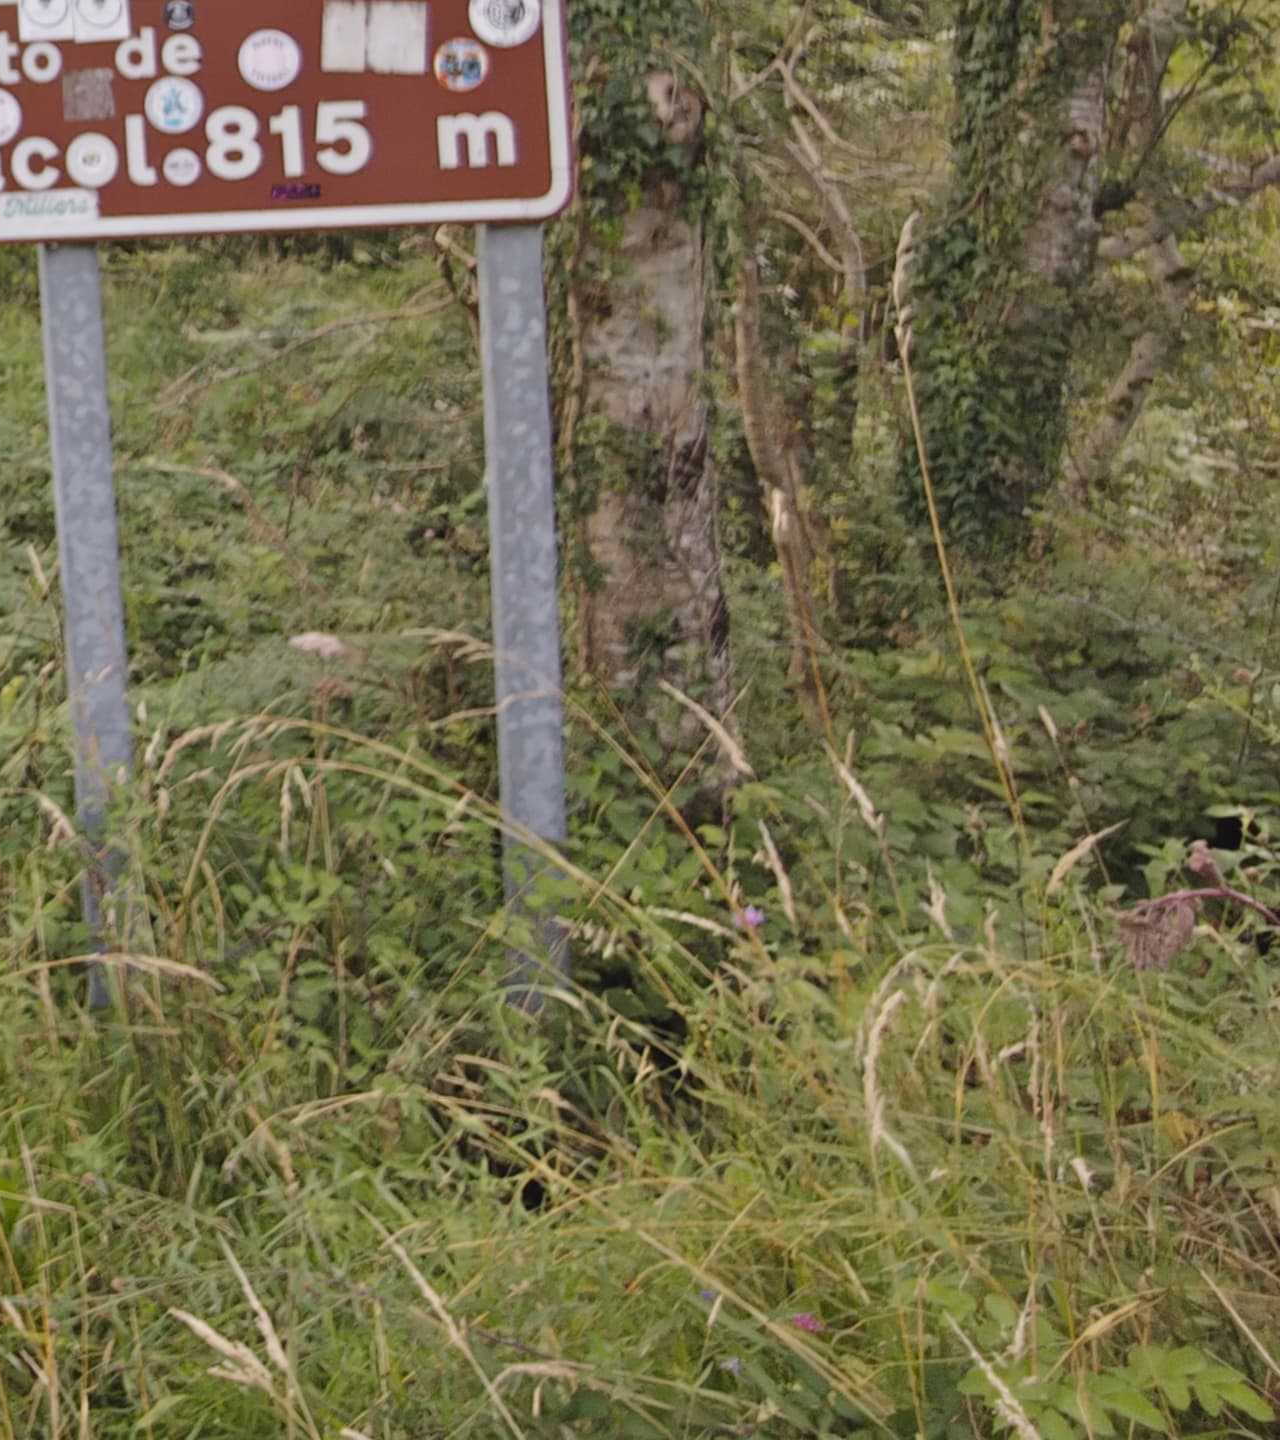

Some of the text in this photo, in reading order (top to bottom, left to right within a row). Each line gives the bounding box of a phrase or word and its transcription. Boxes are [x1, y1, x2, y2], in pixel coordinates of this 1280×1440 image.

[114, 25, 202, 80] de
[205, 100, 372, 181] 815
[437, 111, 517, 171] m
